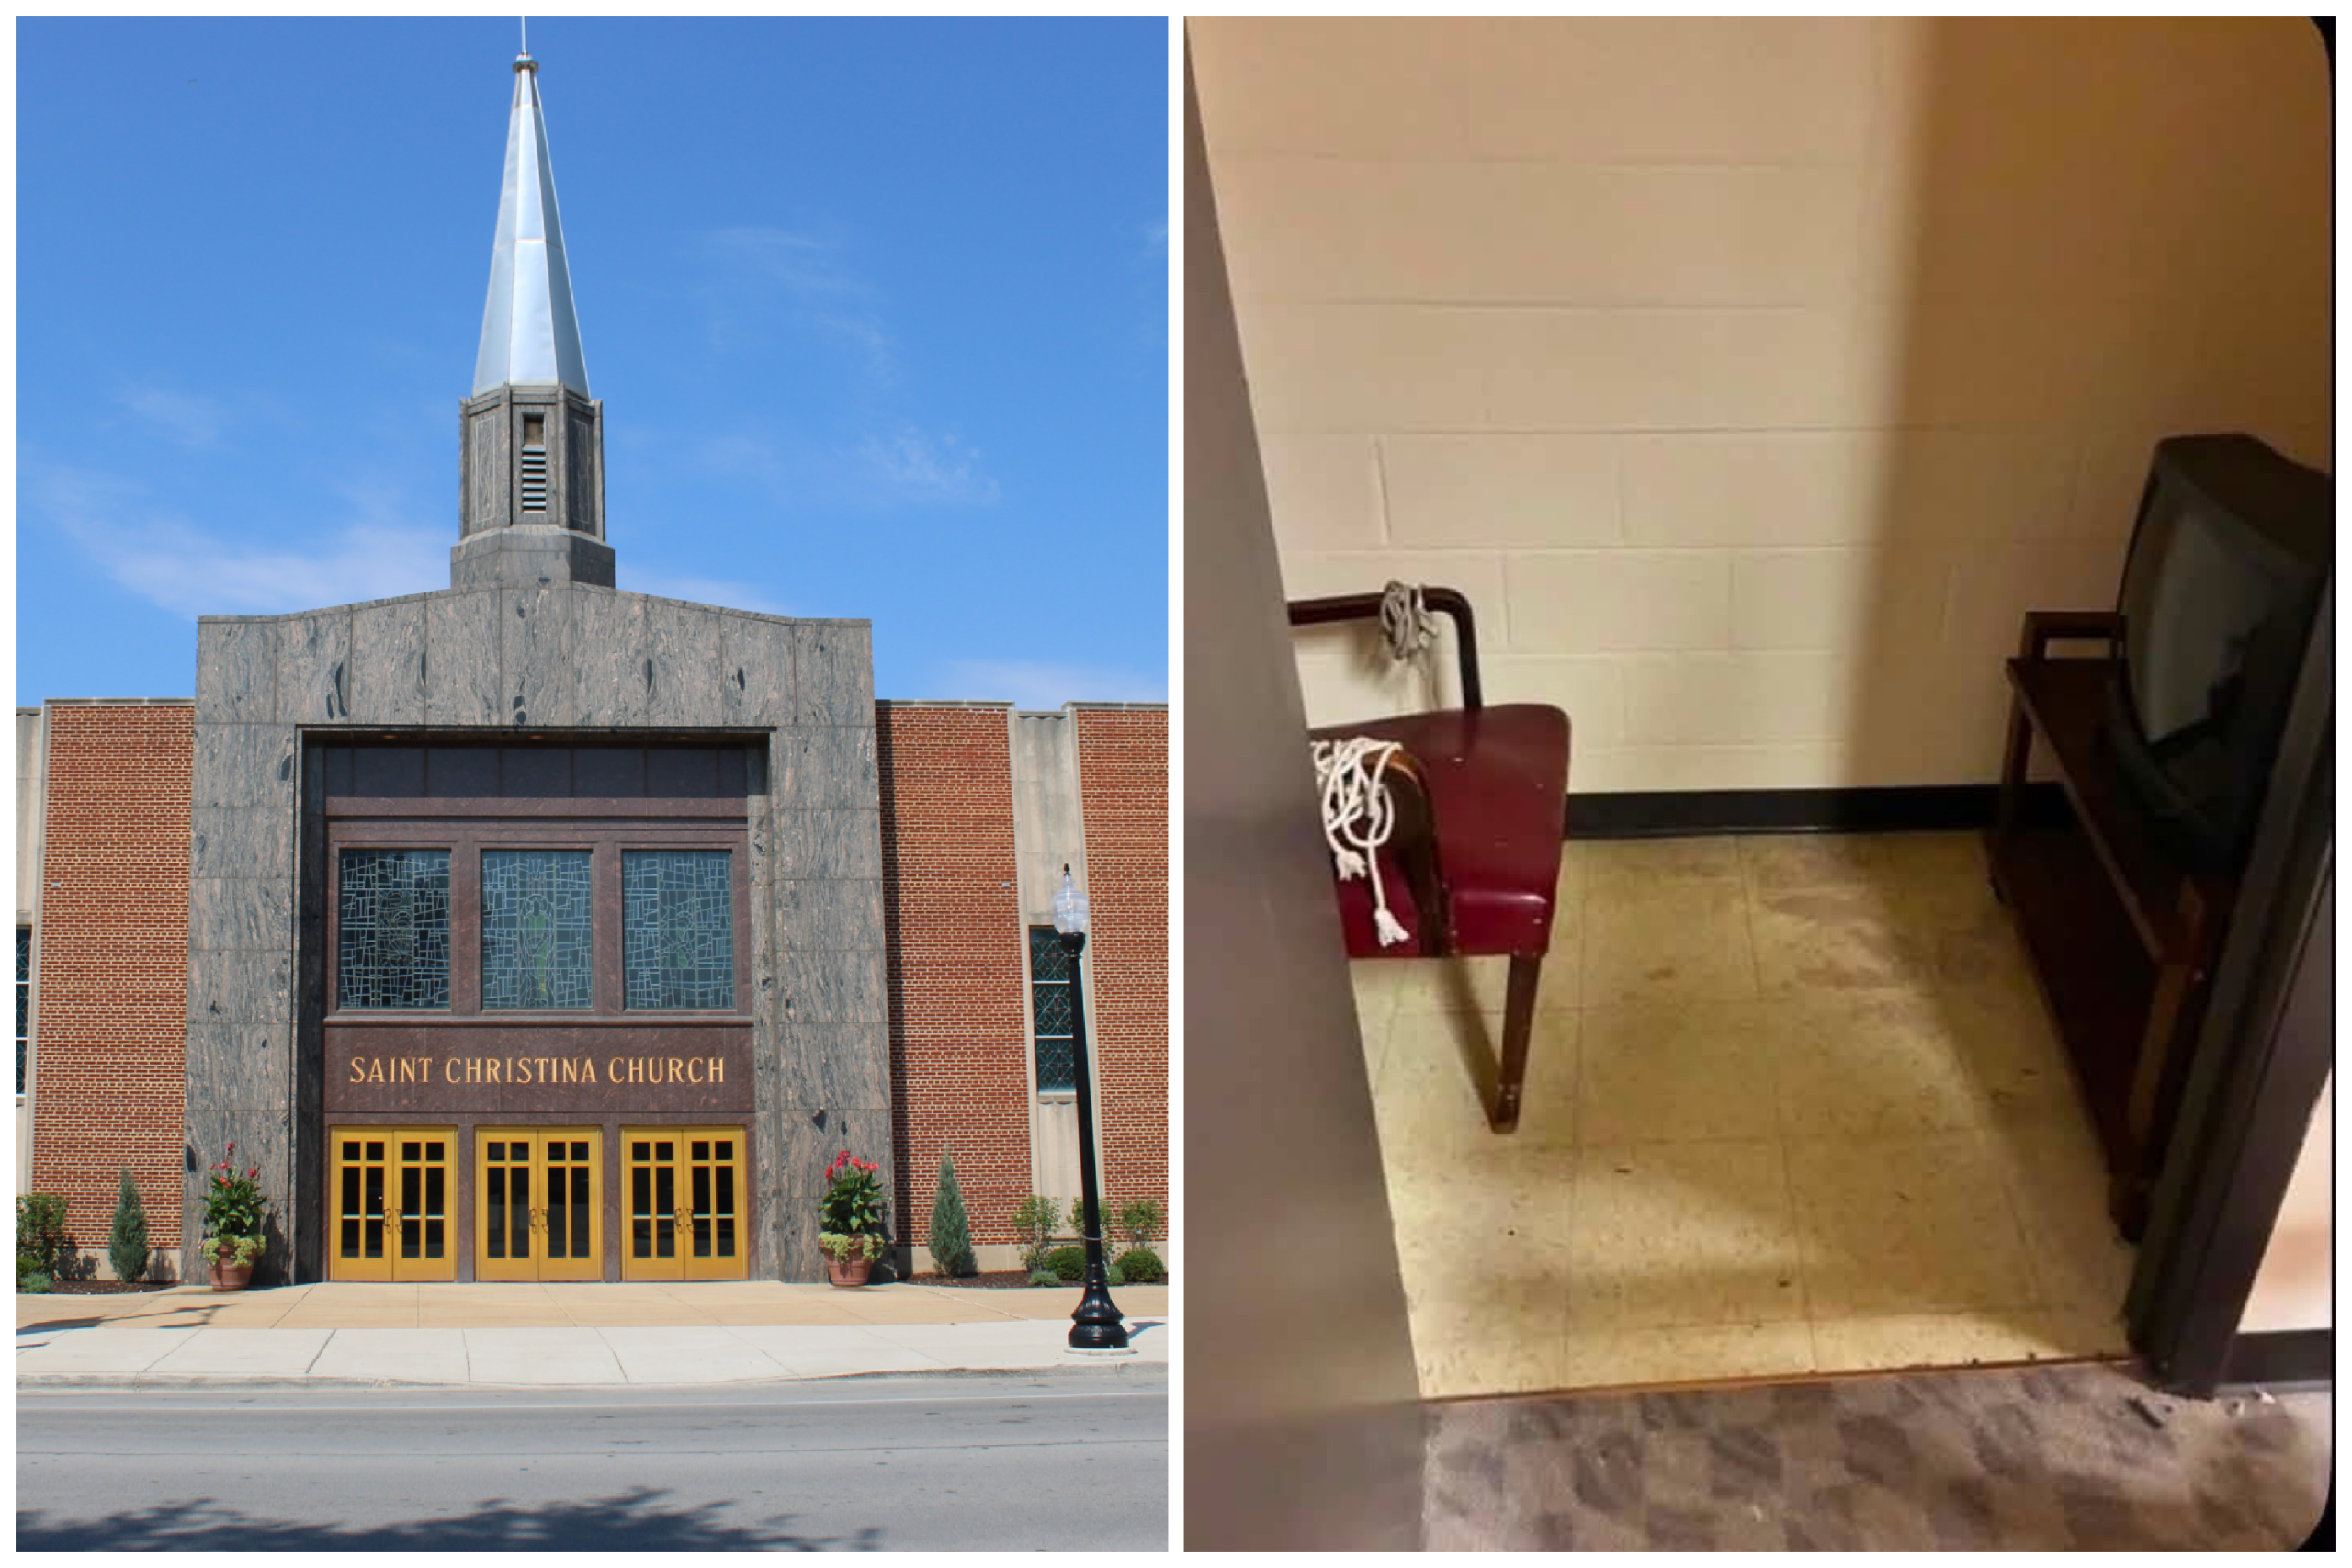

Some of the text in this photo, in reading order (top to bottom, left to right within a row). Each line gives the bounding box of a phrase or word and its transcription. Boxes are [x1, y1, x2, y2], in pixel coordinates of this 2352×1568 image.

[348, 1055, 726, 1085] SAINT CHRISTINA CHURCH
